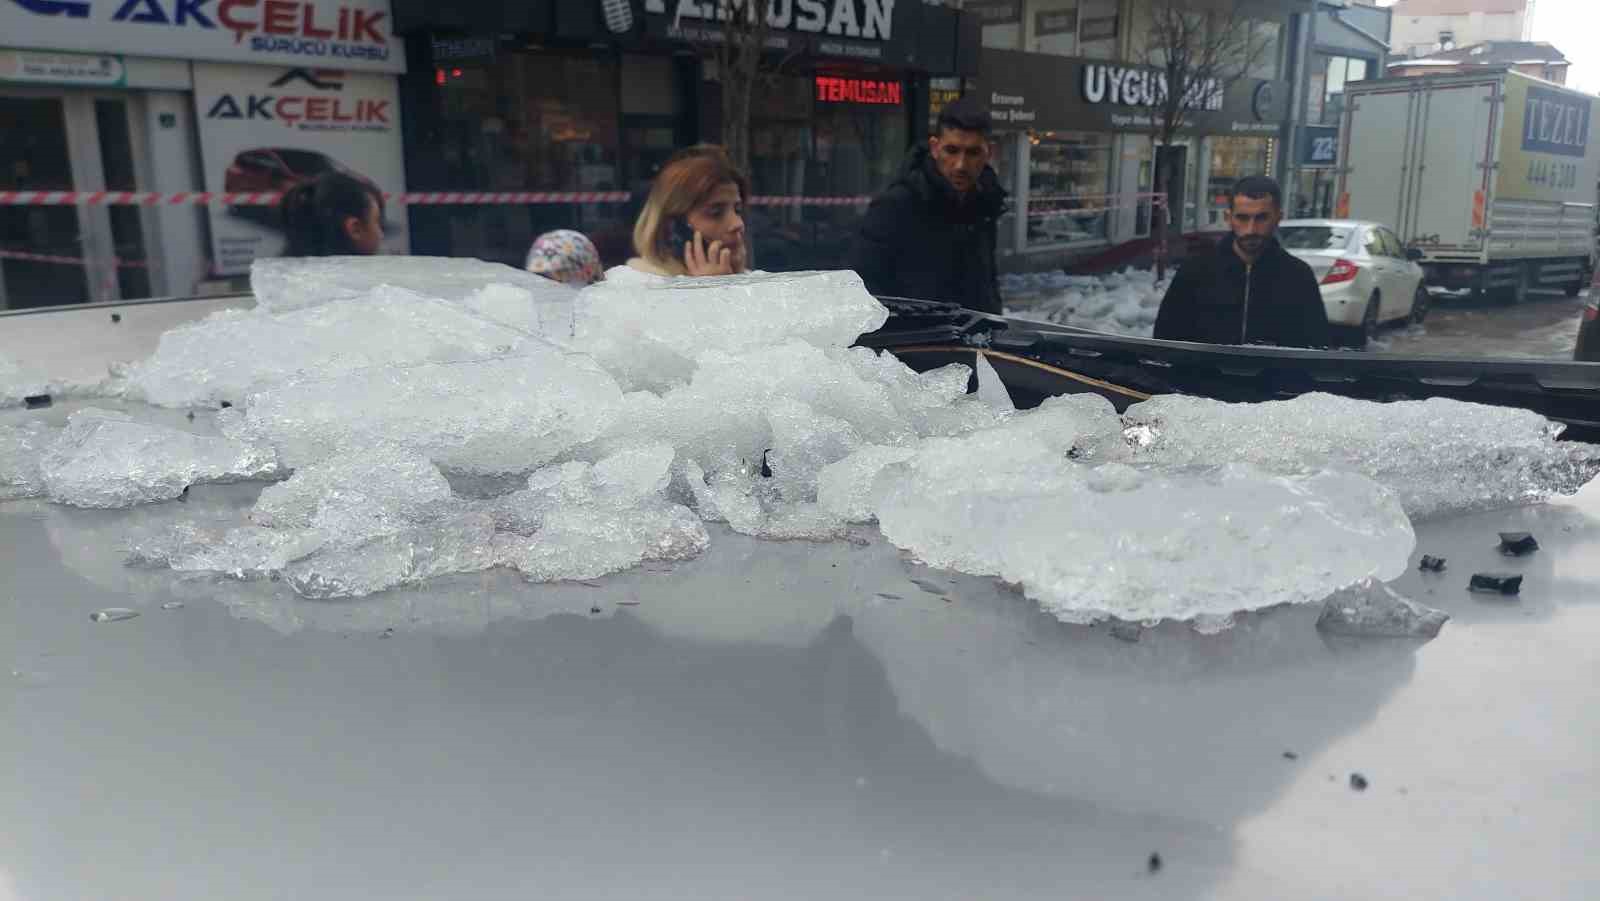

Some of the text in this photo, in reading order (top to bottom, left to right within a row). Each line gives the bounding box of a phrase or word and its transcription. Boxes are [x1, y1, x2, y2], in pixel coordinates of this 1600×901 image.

[251, 36, 390, 62] SÜRÜCÜ KURSU
[815, 77, 901, 104] TEMUSAN
[1527, 98, 1586, 147] TEZEL
